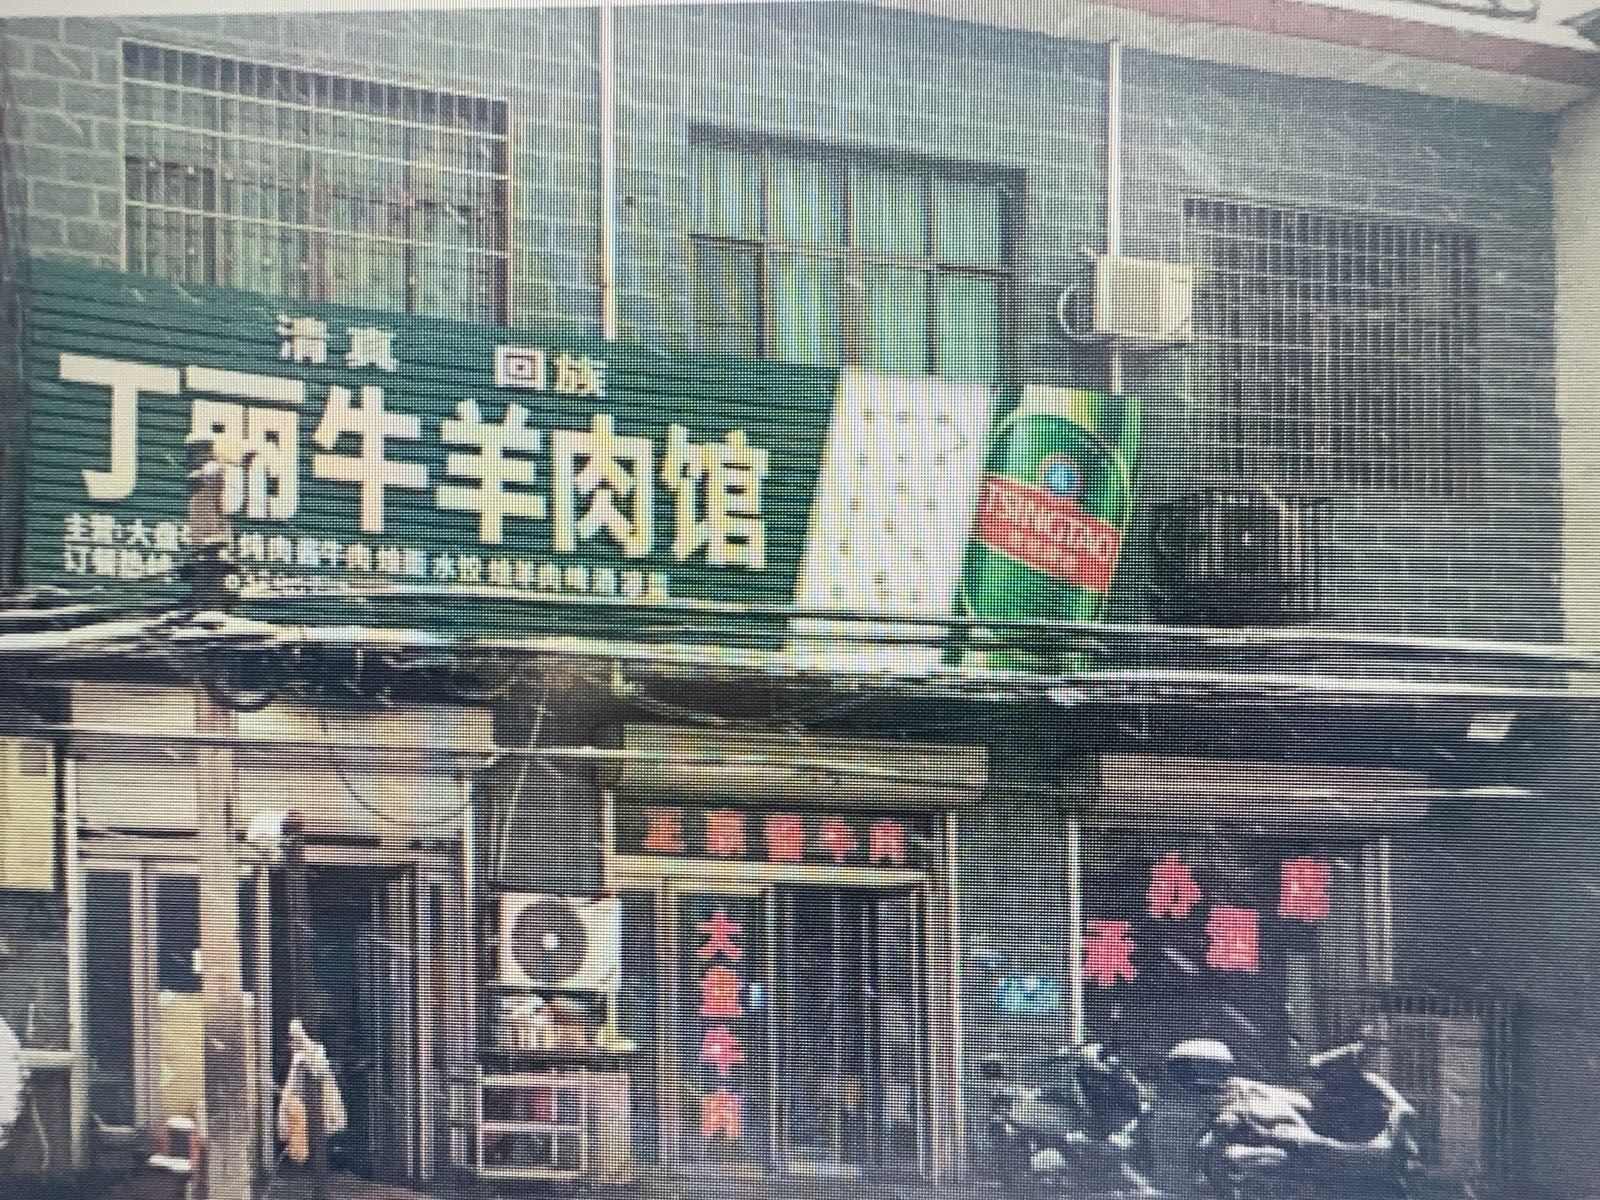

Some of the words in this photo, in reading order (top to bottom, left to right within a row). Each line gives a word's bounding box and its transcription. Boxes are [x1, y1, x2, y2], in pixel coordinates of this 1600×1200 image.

[275, 313, 398, 372] 清真
[493, 344, 607, 399] 回族
[57, 351, 770, 570] 丁丽牛羊肉馆
[985, 481, 1116, 564] TSINGTAO
